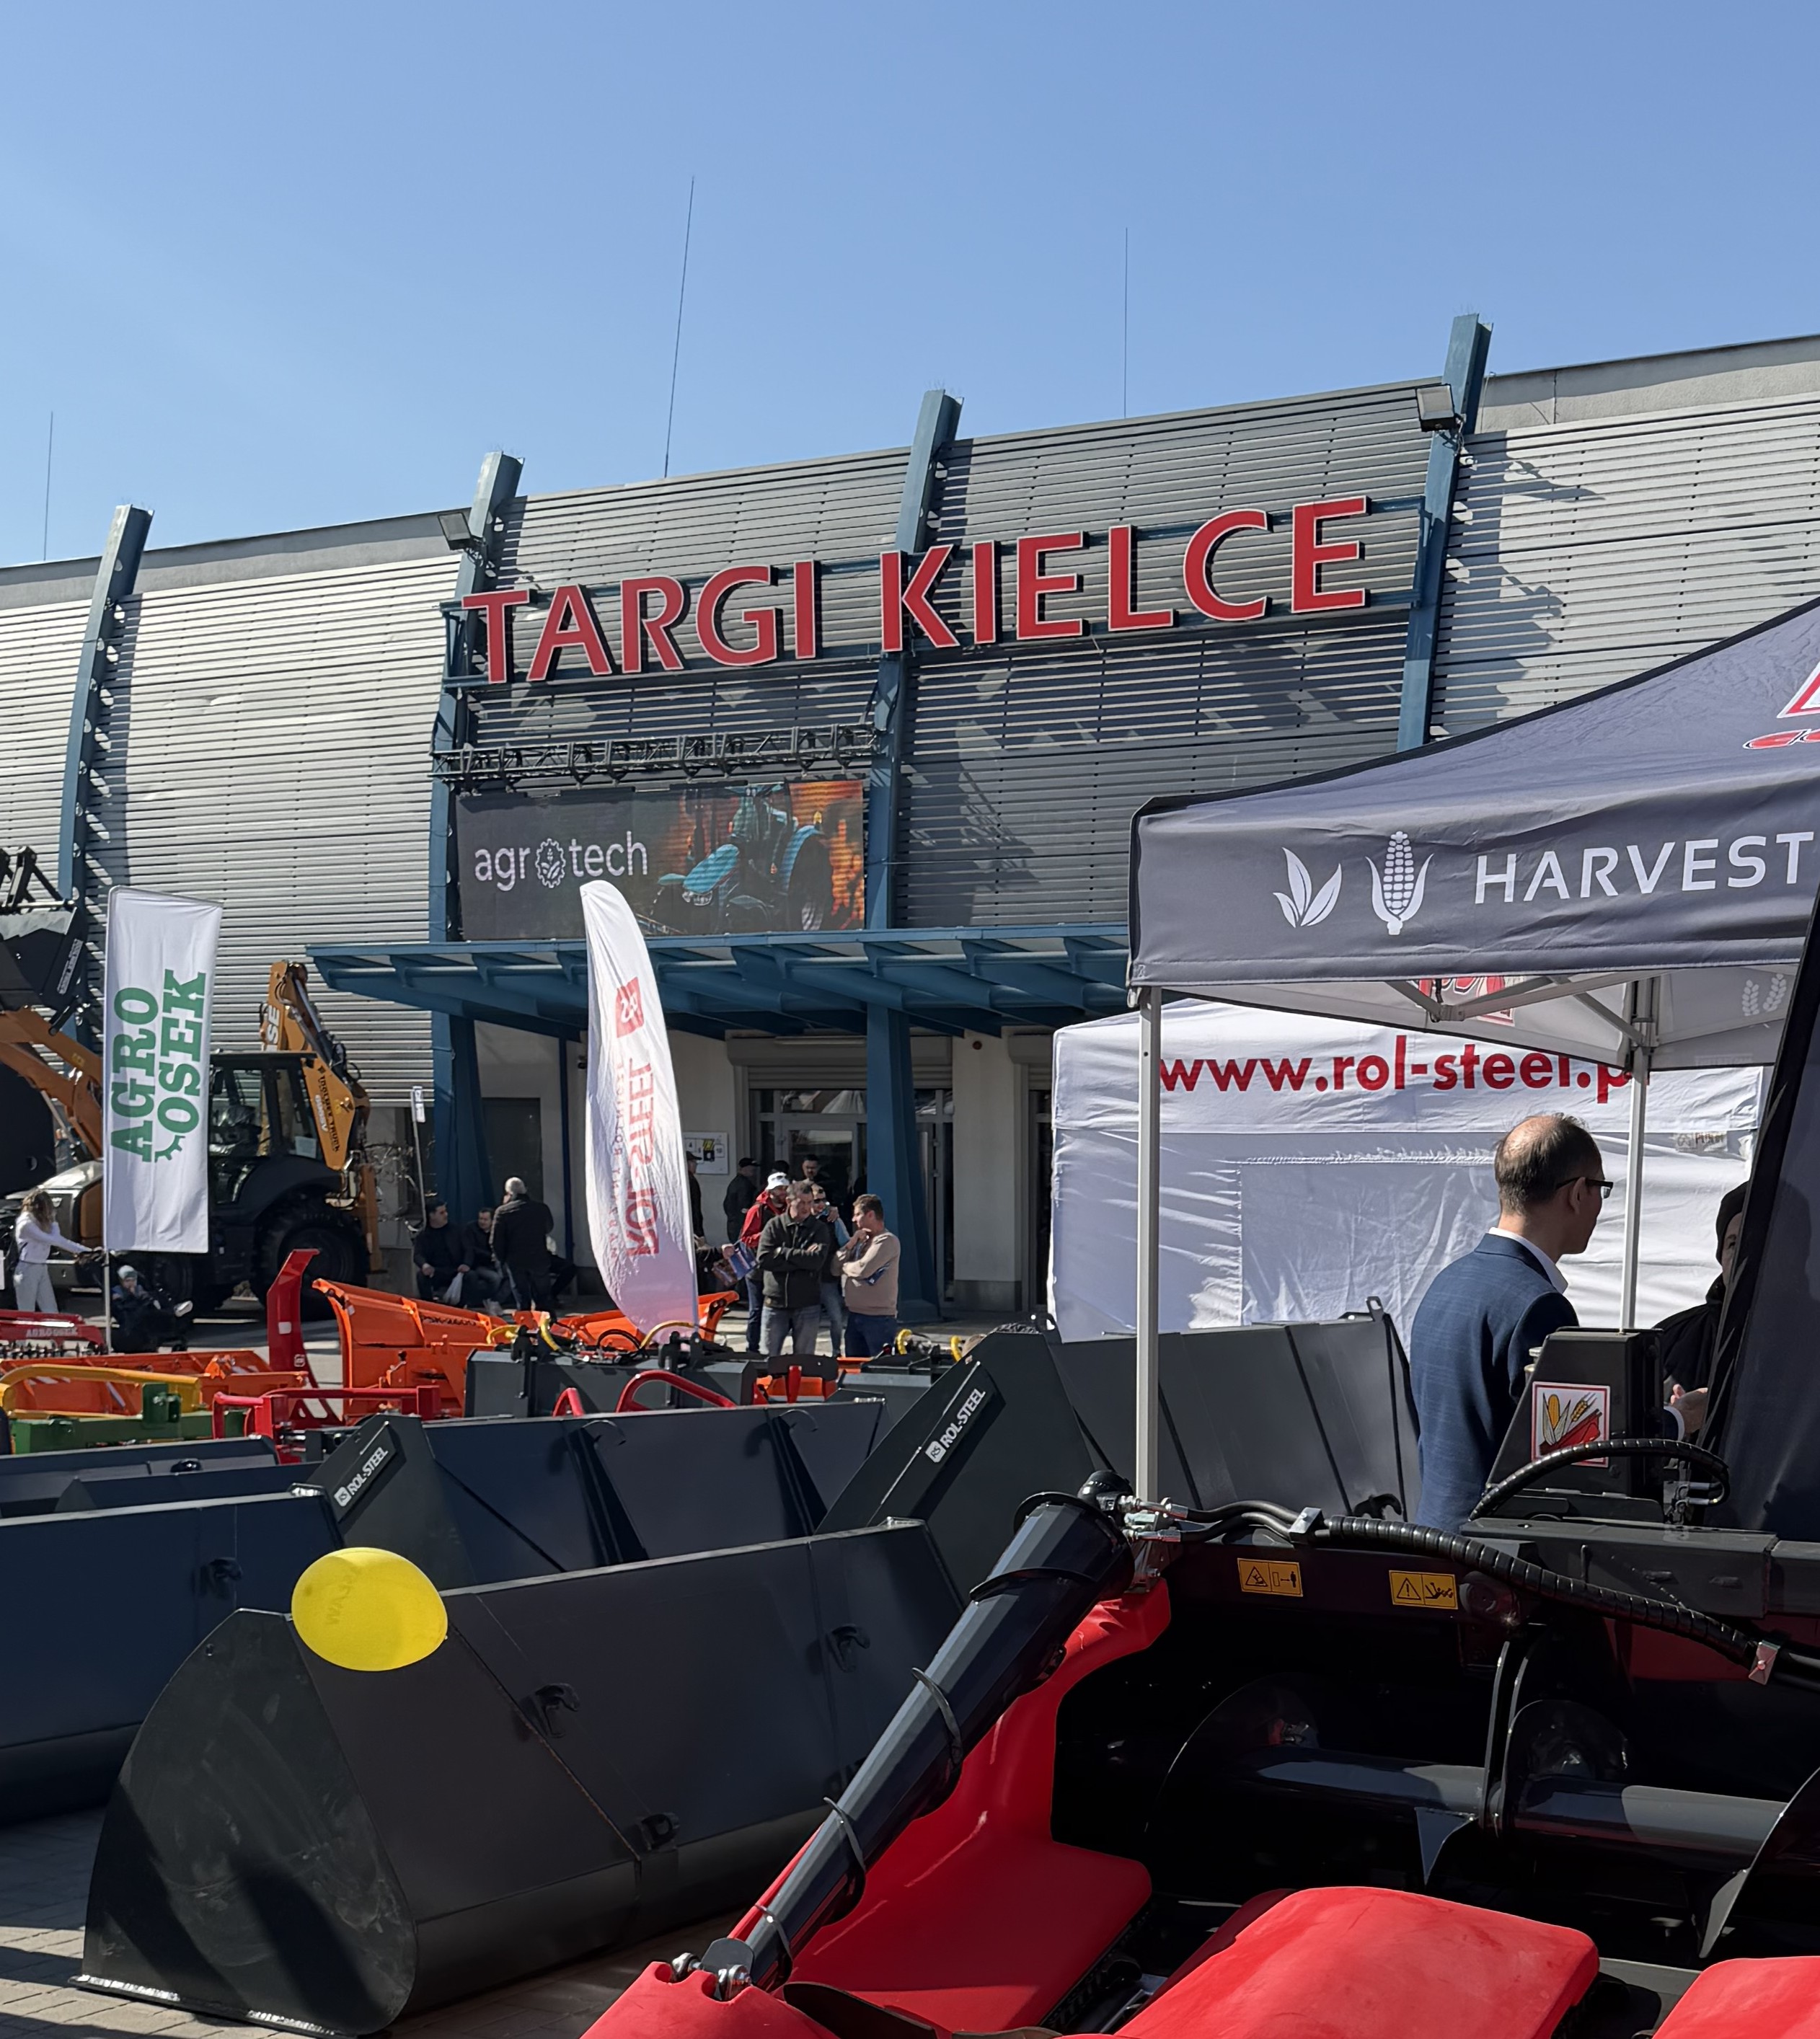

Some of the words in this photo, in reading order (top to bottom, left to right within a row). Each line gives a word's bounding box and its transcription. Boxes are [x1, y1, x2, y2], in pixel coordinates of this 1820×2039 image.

[461, 560, 820, 684] TARGI
[879, 495, 1371, 652] KIELCE
[1475, 831, 1814, 904] HARVEST
[111, 987, 159, 1162] AGRO
[157, 969, 206, 1134] OSEK
[1159, 1035, 1637, 1104] www.rol-steel.p
[940, 1388, 986, 1448] ROL-STEEL
[347, 1446, 389, 1496] ROL-STEEL
